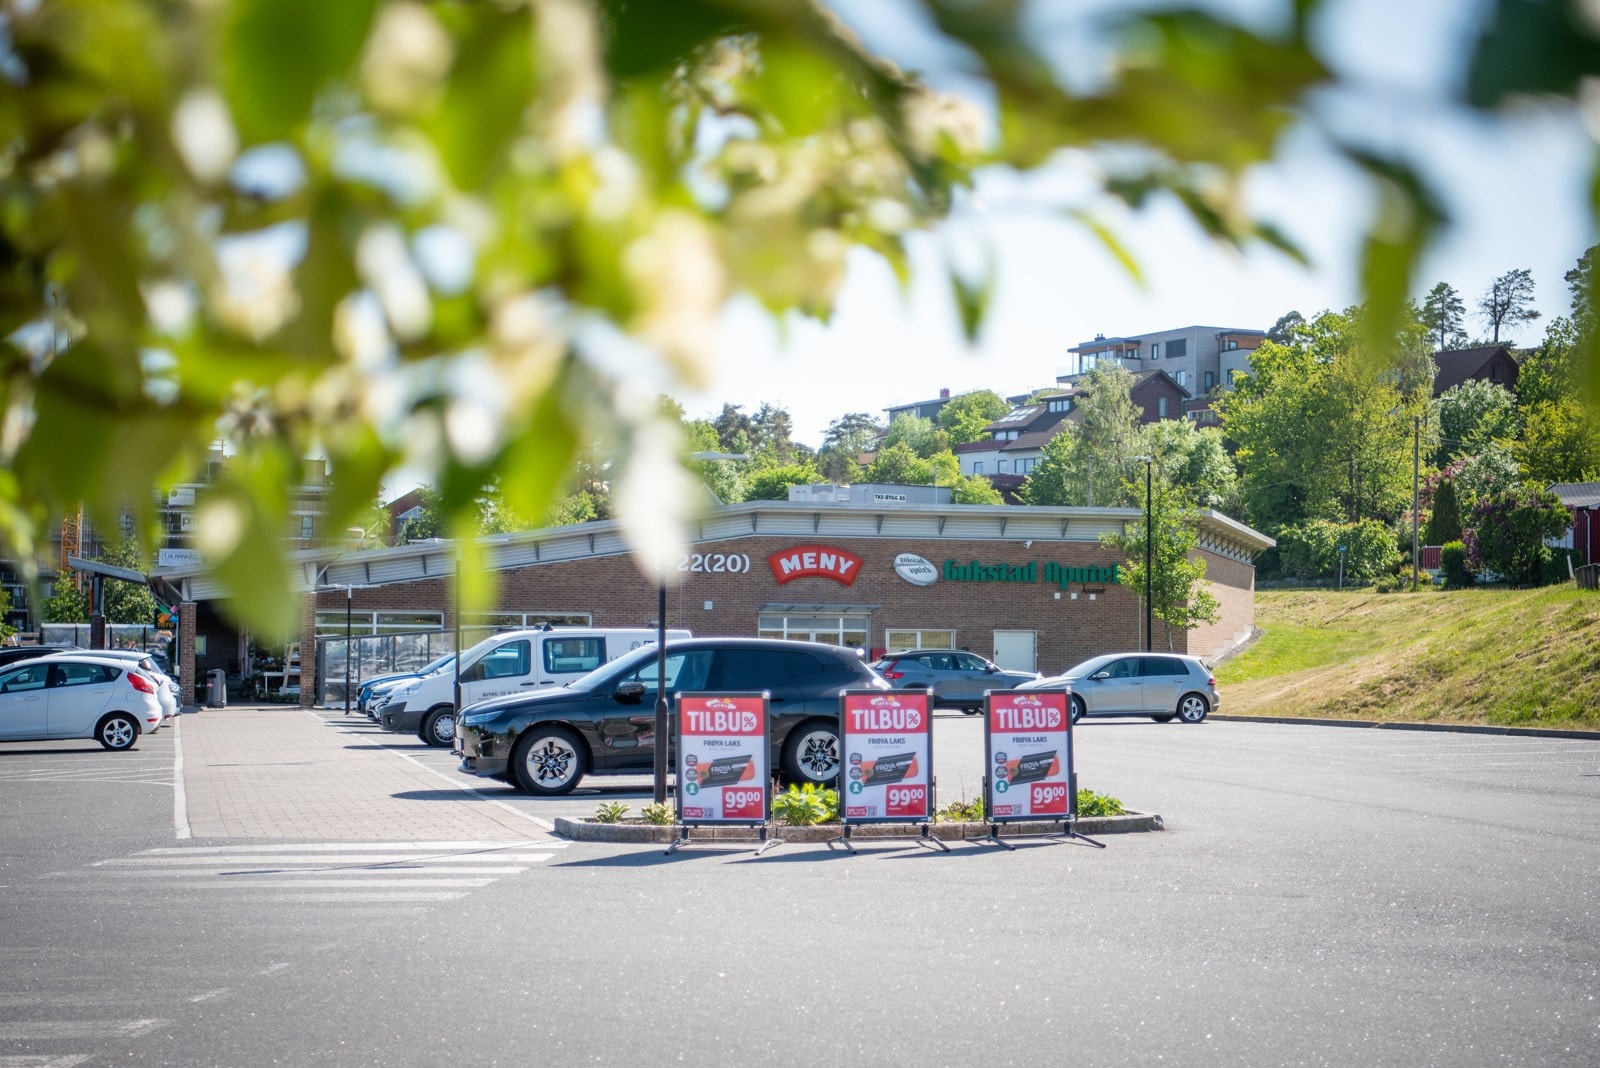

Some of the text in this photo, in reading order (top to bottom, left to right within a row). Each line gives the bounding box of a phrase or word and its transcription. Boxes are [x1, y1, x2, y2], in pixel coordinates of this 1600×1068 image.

[780, 552, 854, 574] MENY
[944, 559, 1037, 583] Gokstad
[889, 737, 906, 745] LAKS
